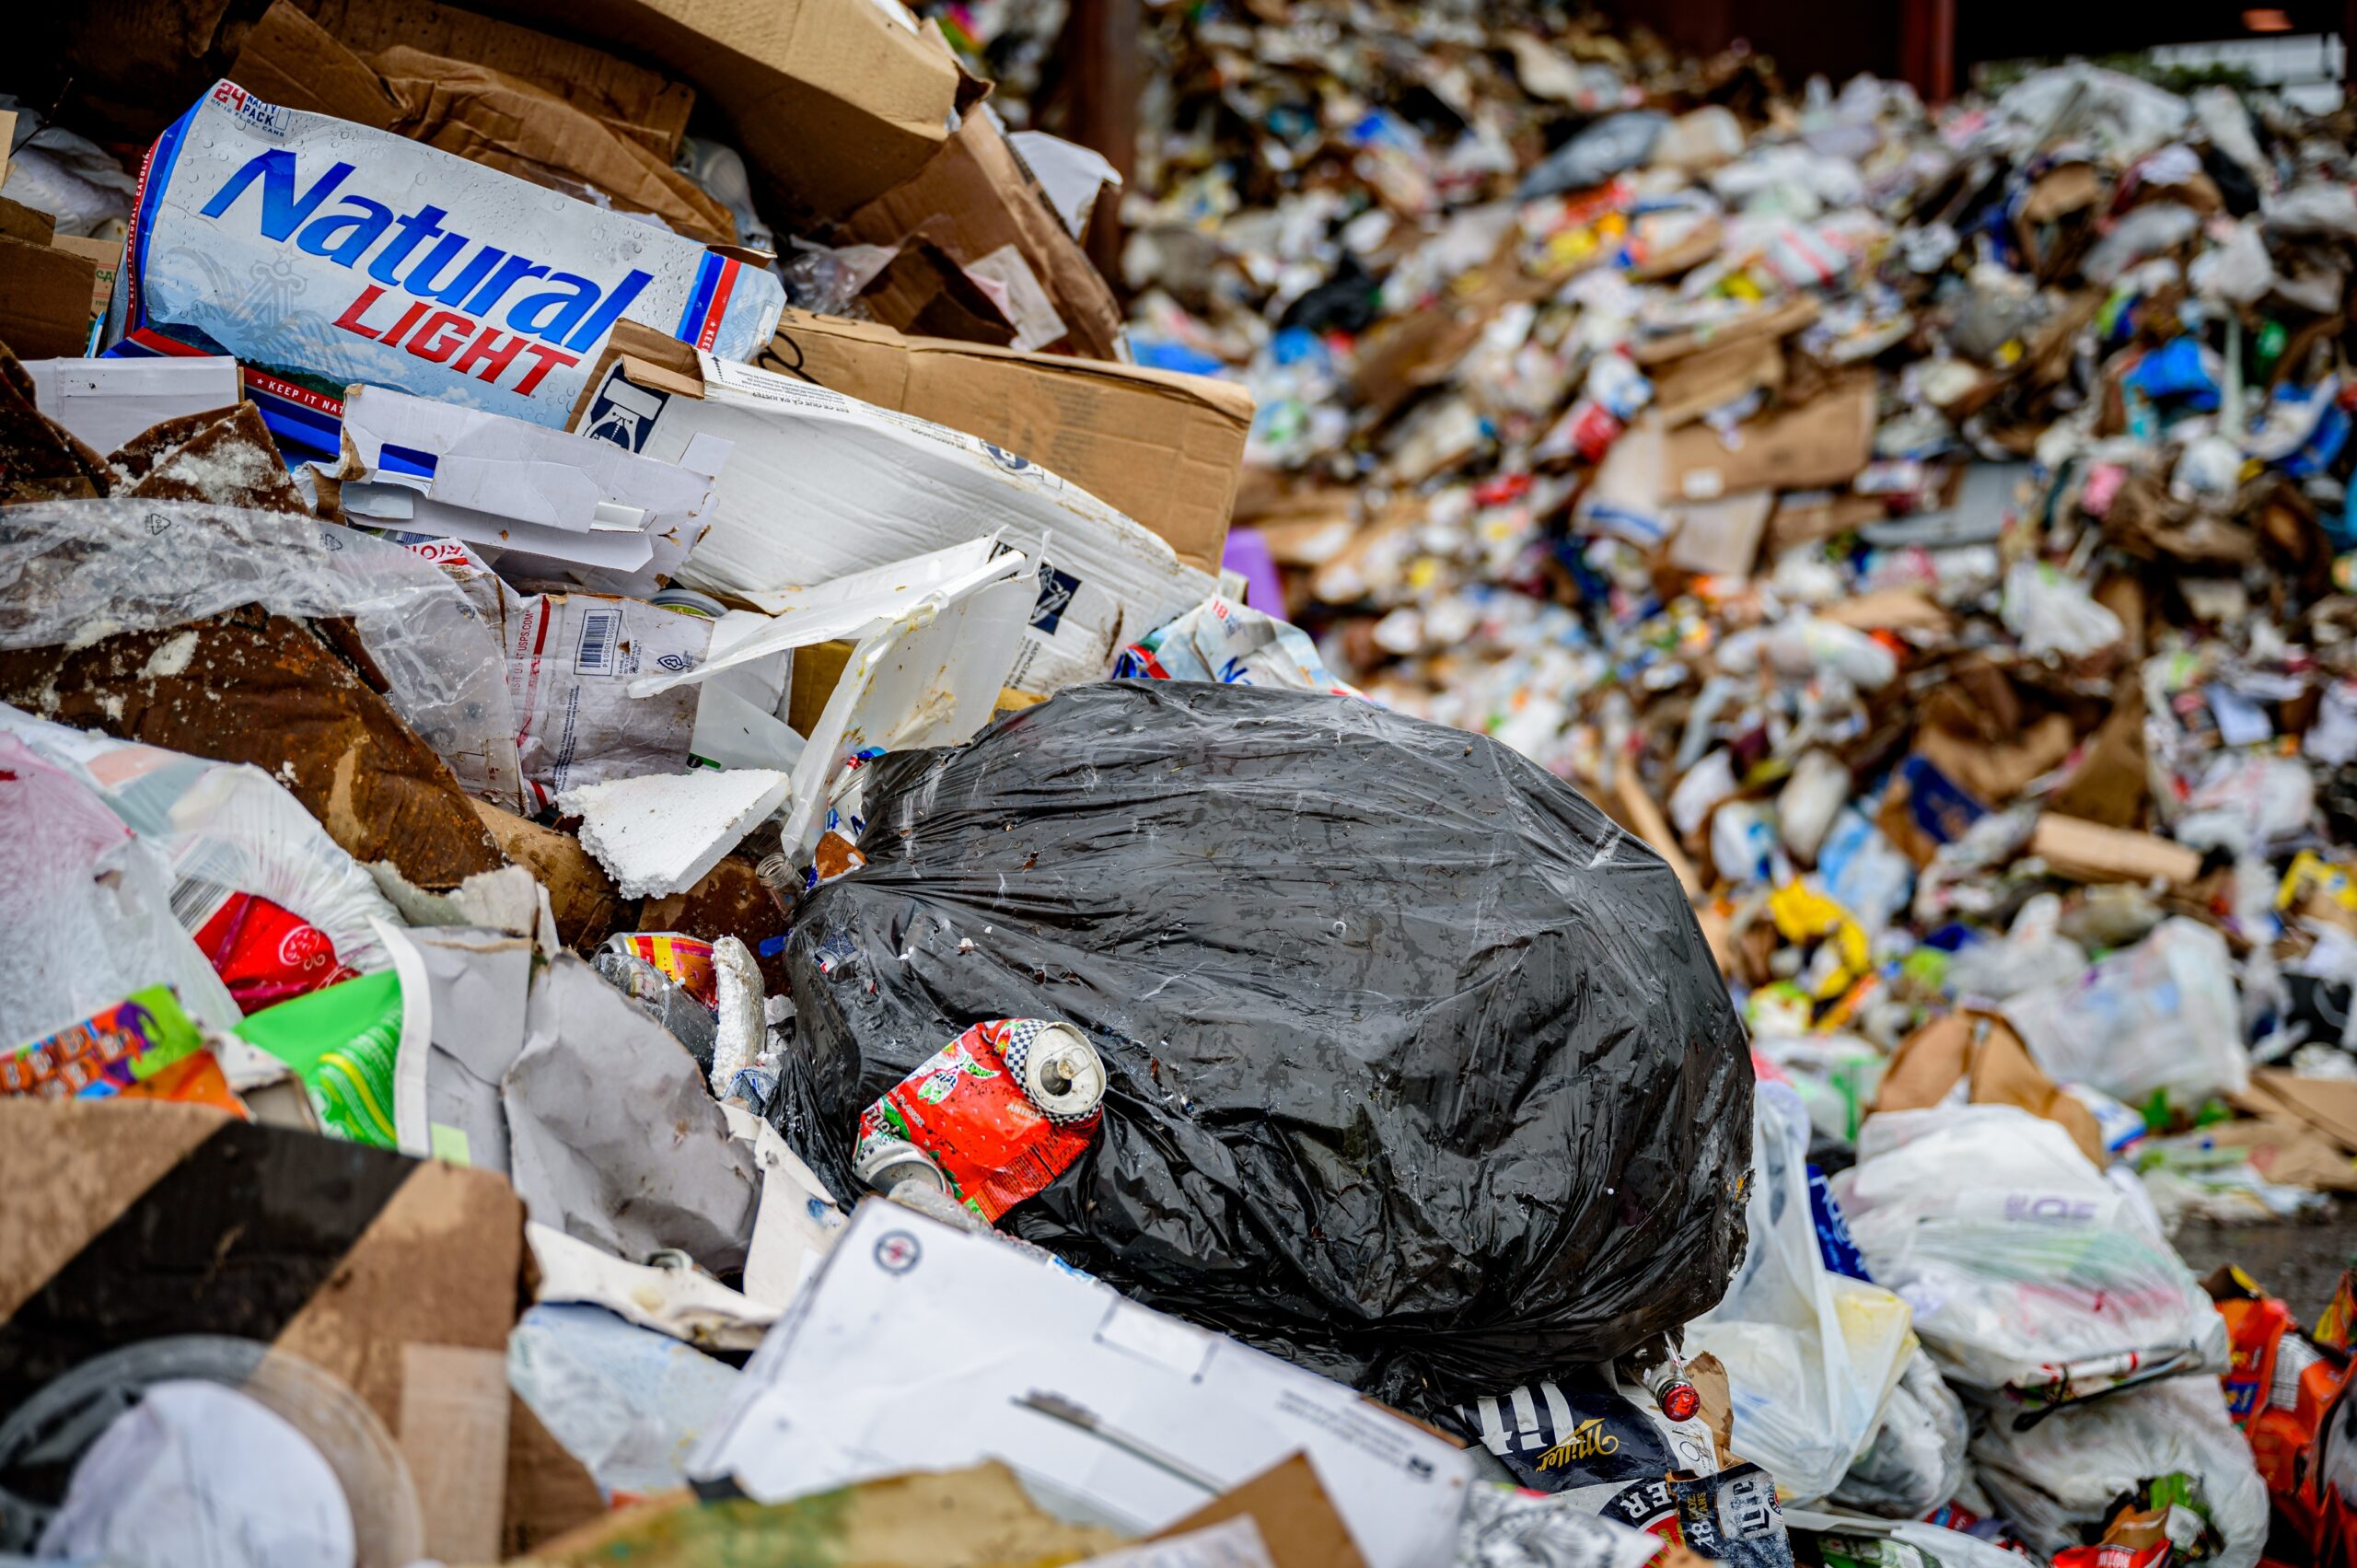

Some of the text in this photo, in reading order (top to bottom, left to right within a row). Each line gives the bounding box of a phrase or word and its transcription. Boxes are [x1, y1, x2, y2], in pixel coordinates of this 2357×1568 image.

[213, 81, 249, 111] 24
[242, 104, 274, 127] PACK
[200, 148, 653, 354] Natural
[129, 273, 137, 299] KEEP
[332, 284, 581, 397] LIGHT
[268, 380, 300, 399] KEEP
[304, 393, 318, 405] IT
[1535, 1416, 1620, 1475] Miller
[1691, 1520, 1715, 1546] 18
